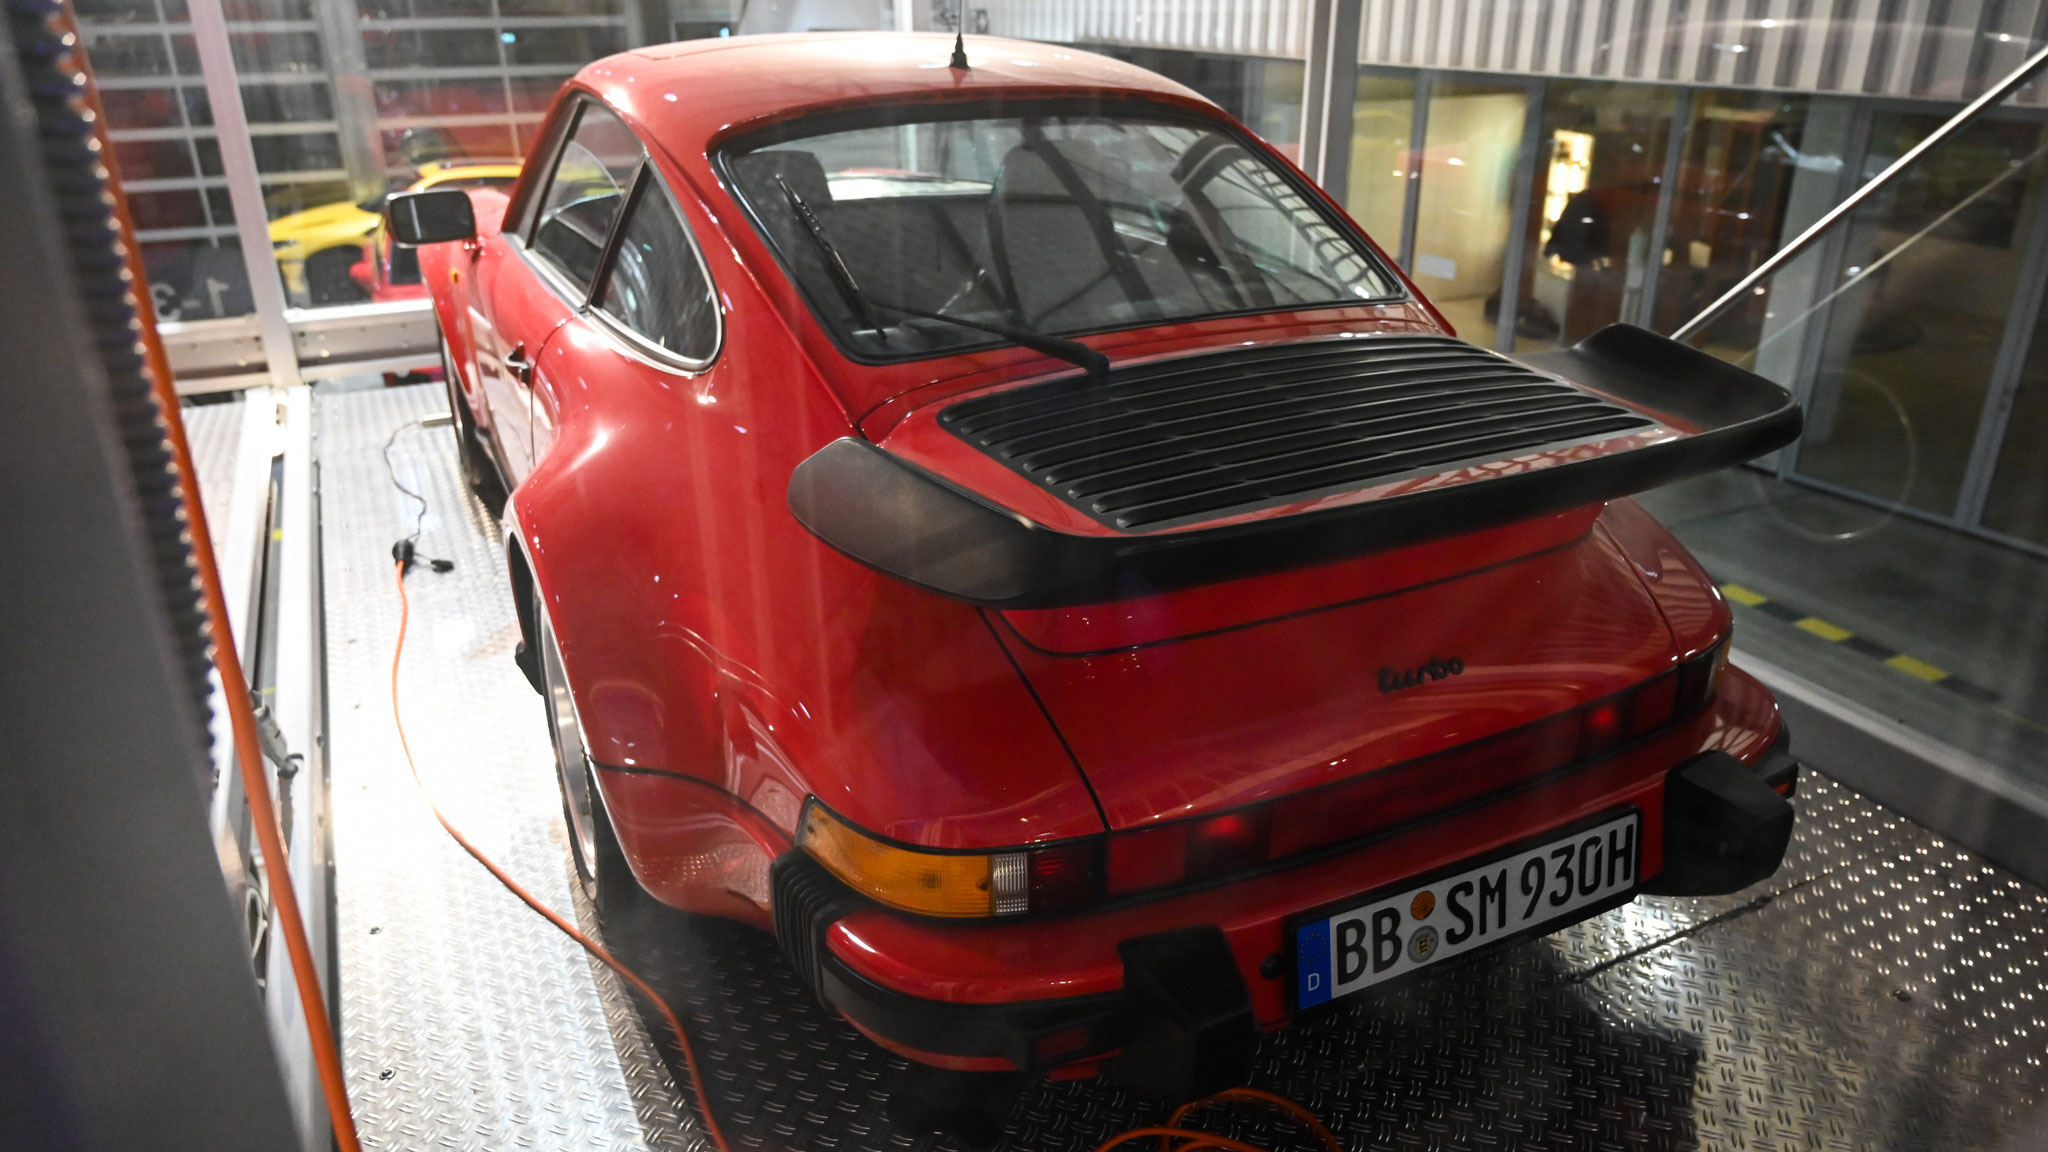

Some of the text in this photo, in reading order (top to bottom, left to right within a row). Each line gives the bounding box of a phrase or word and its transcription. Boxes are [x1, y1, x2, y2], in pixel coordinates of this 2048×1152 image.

[1377, 657, 1465, 694] turbo
[1336, 906, 1402, 986] BB
[1445, 867, 1507, 946] SM
[1520, 823, 1634, 921] 930H
[1308, 972, 1321, 991] D
